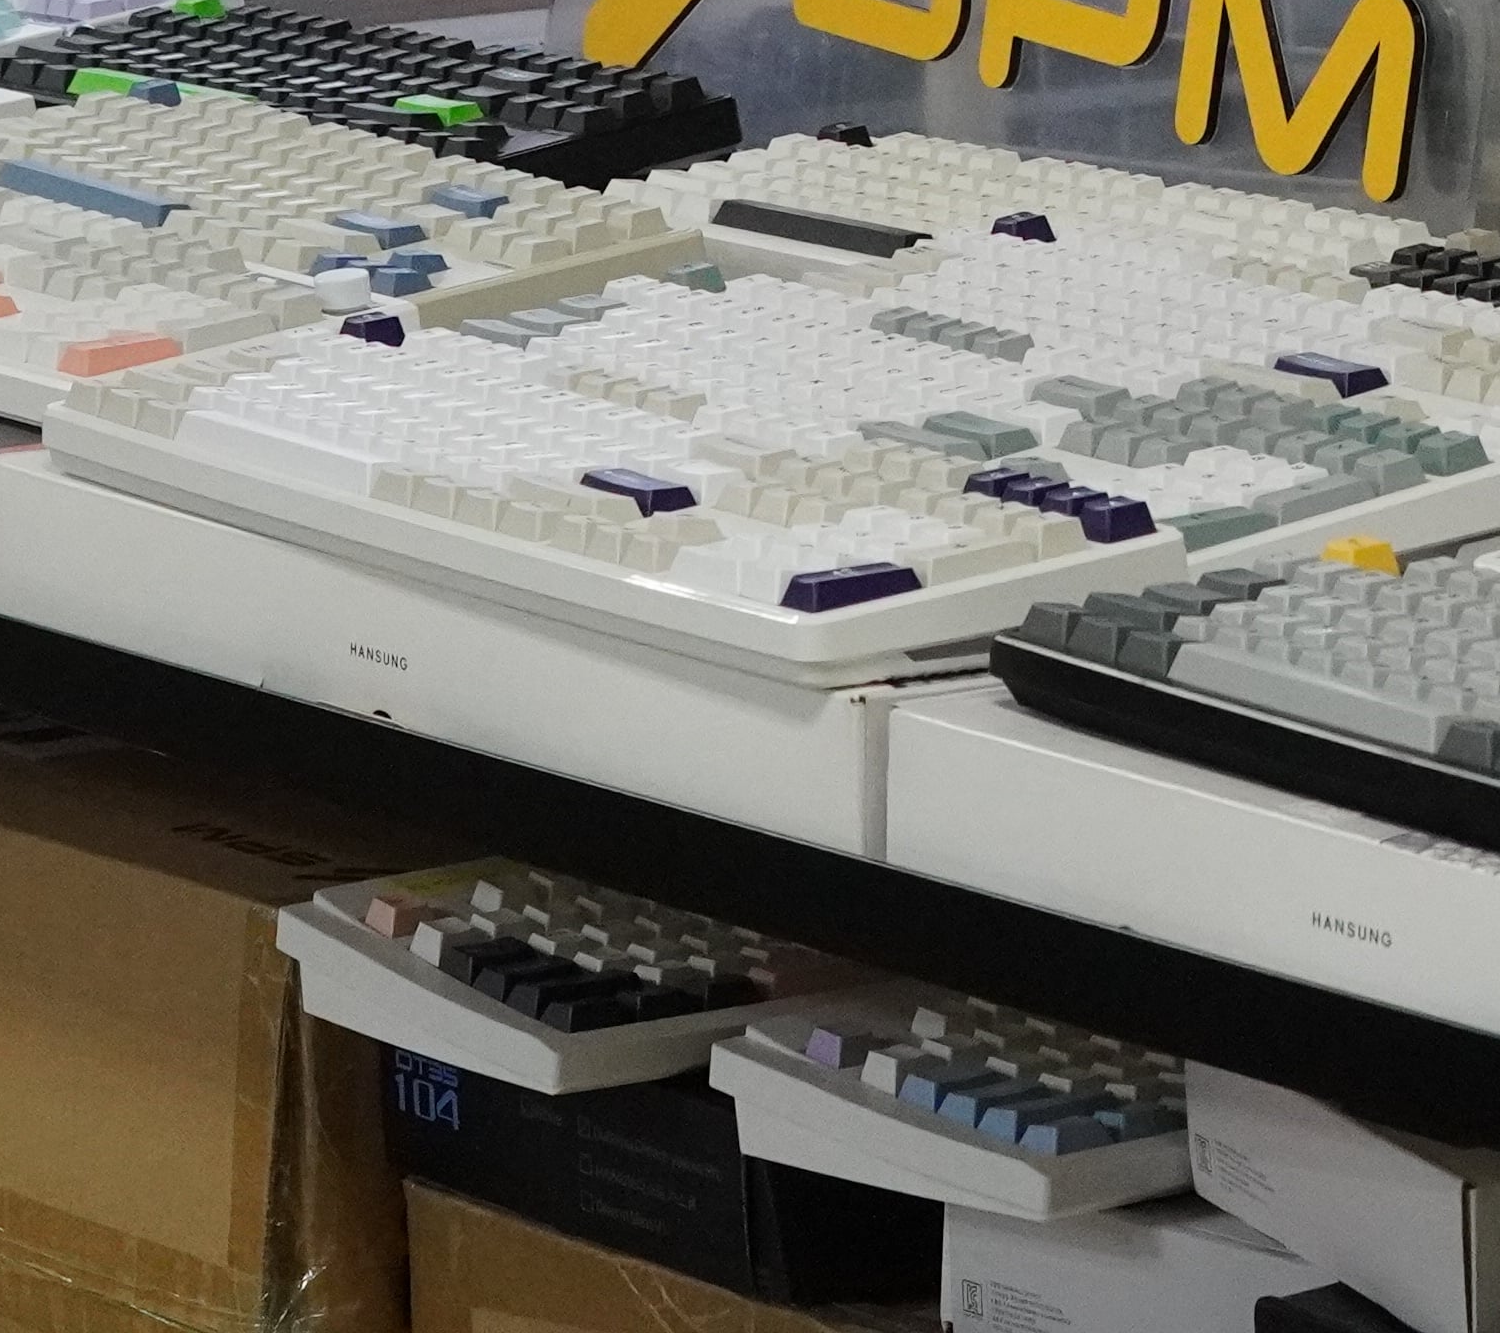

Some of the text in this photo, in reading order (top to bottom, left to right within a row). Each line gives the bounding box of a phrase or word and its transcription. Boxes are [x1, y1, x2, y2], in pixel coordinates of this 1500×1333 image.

[349, 640, 411, 673] HANSUNG
[1311, 910, 1394, 950] HANSUNG
[395, 1073, 461, 1131] 104
